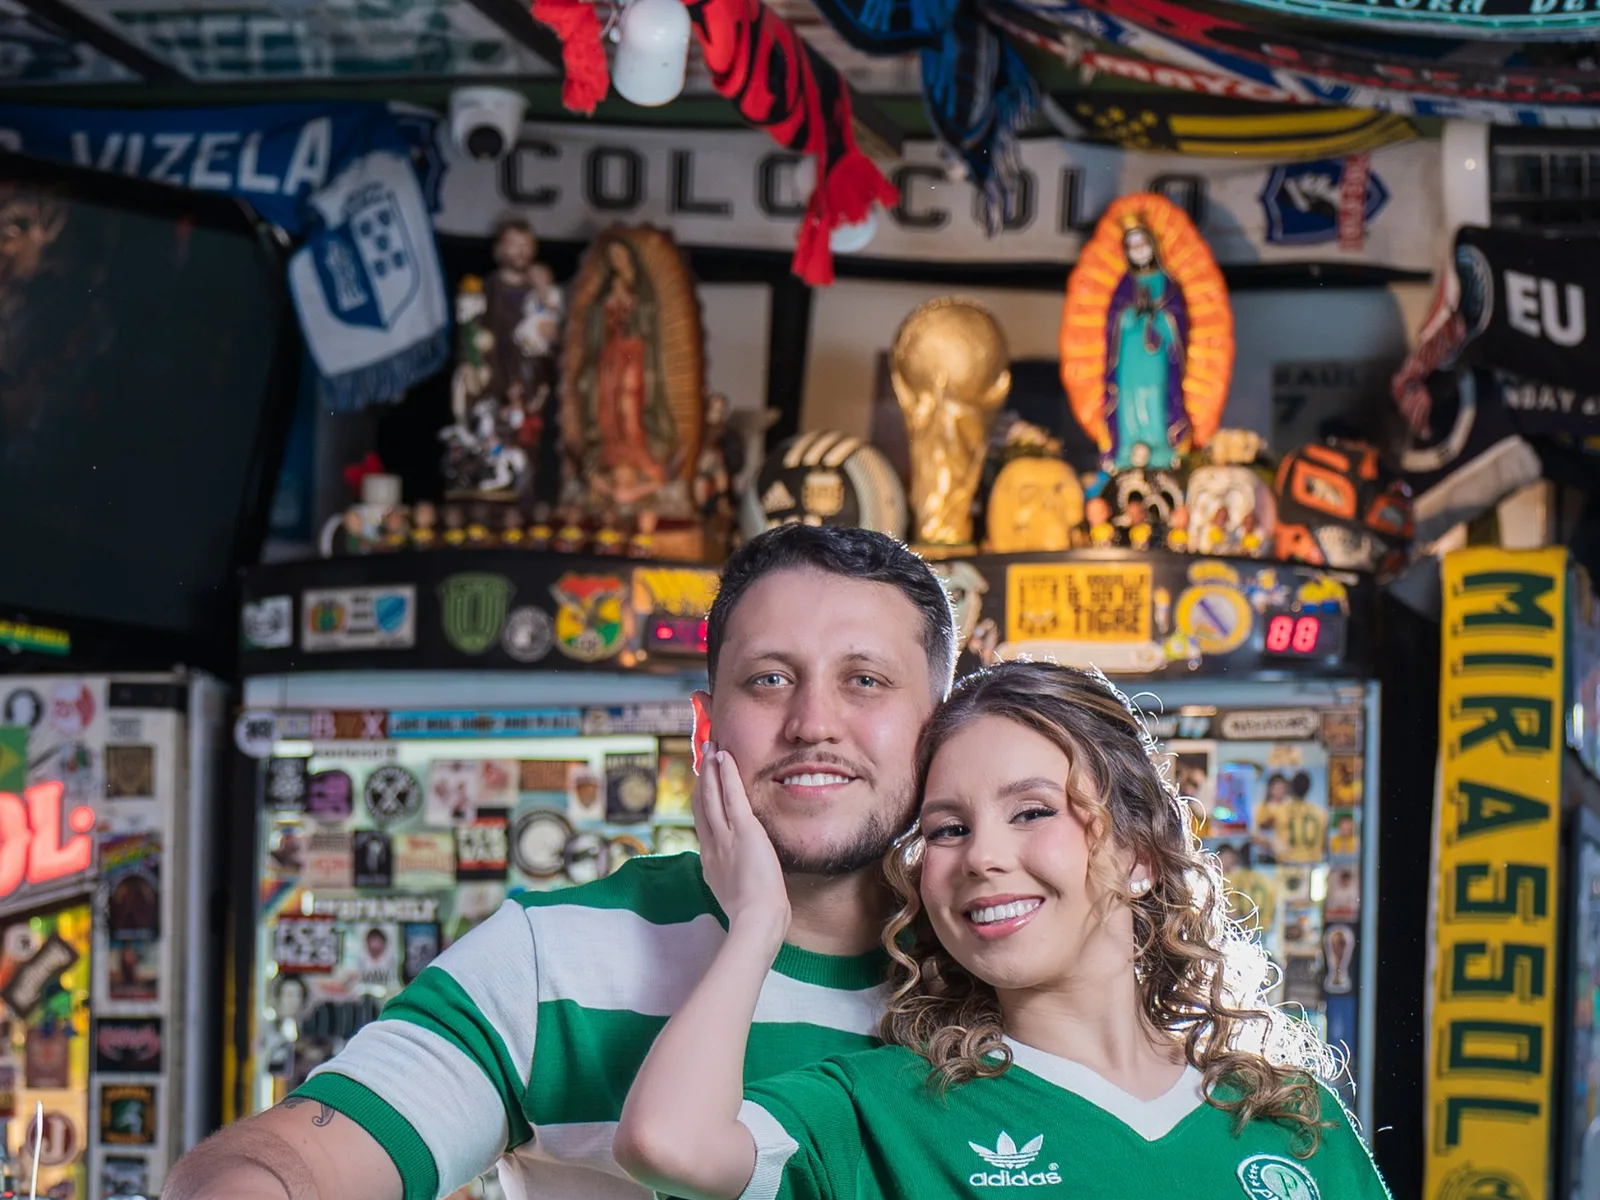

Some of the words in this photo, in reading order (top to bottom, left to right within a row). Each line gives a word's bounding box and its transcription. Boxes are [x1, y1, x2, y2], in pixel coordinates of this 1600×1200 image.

[70, 117, 332, 195] VIZELA
[1504, 269, 1586, 347] EU
[1266, 616, 1319, 651] 88
[1441, 569, 1556, 1150] MIRASSOL
[969, 1169, 1062, 1187] adidas
